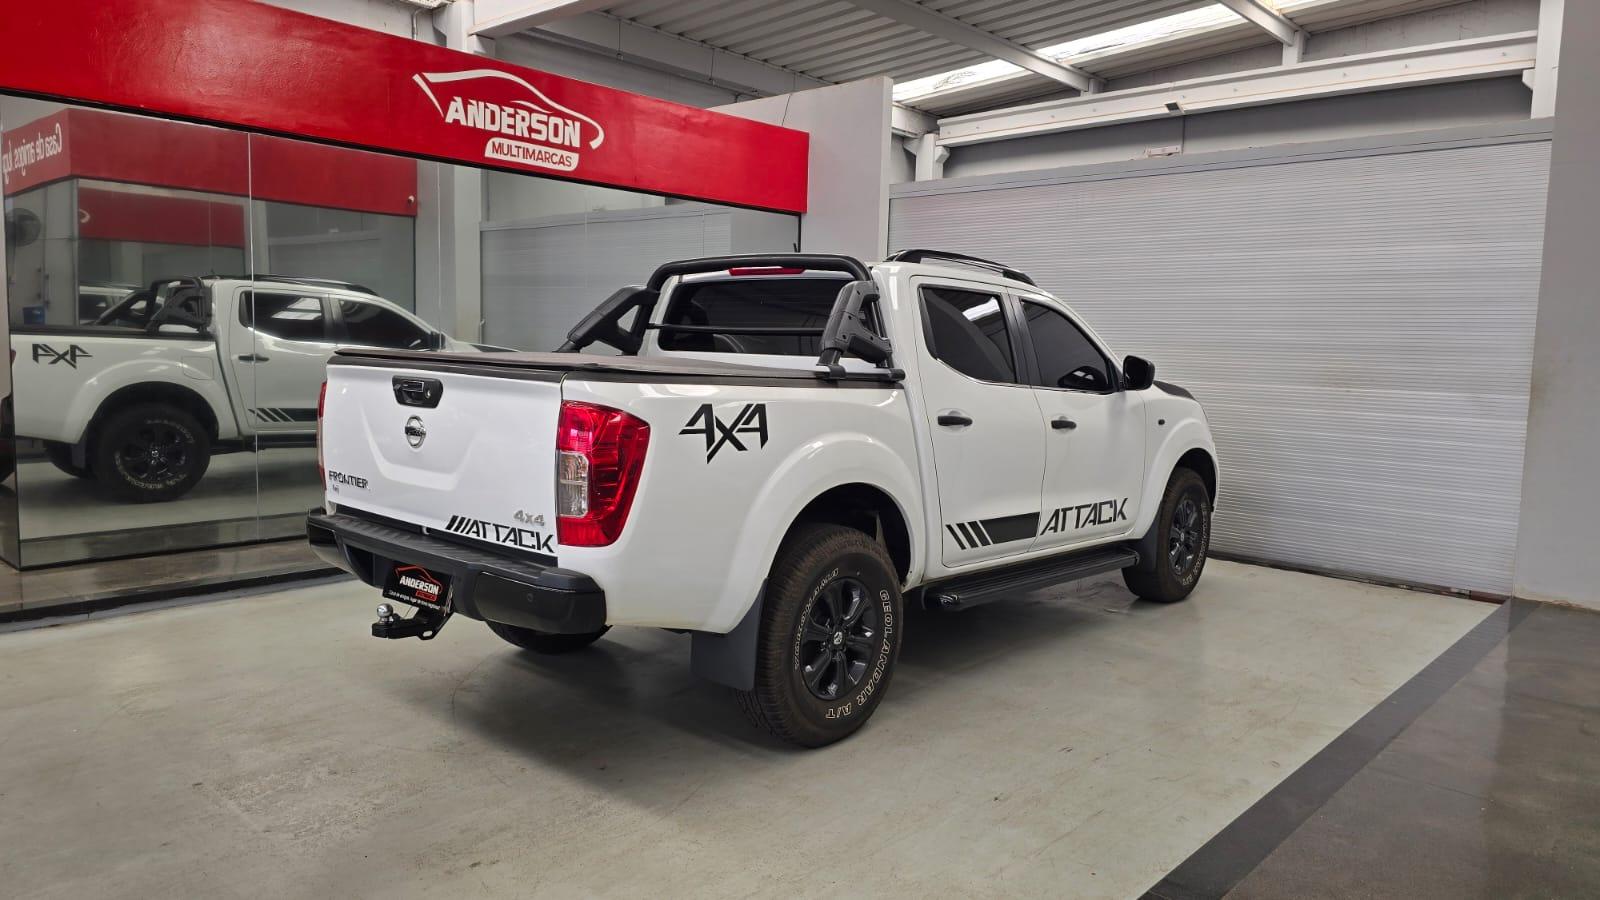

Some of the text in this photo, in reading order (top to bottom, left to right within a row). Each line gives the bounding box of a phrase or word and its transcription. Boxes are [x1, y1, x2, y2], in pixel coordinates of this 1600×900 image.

[445, 96, 581, 148] ANDERSON
[491, 140, 573, 168] MULTIMARCAS
[328, 470, 369, 489] FRONTIER
[1039, 497, 1129, 536] ATTACK
[465, 520, 555, 554] ATTACK
[399, 575, 440, 595] ANDERSON
[825, 589, 893, 719] GEOLANDAR A/T
